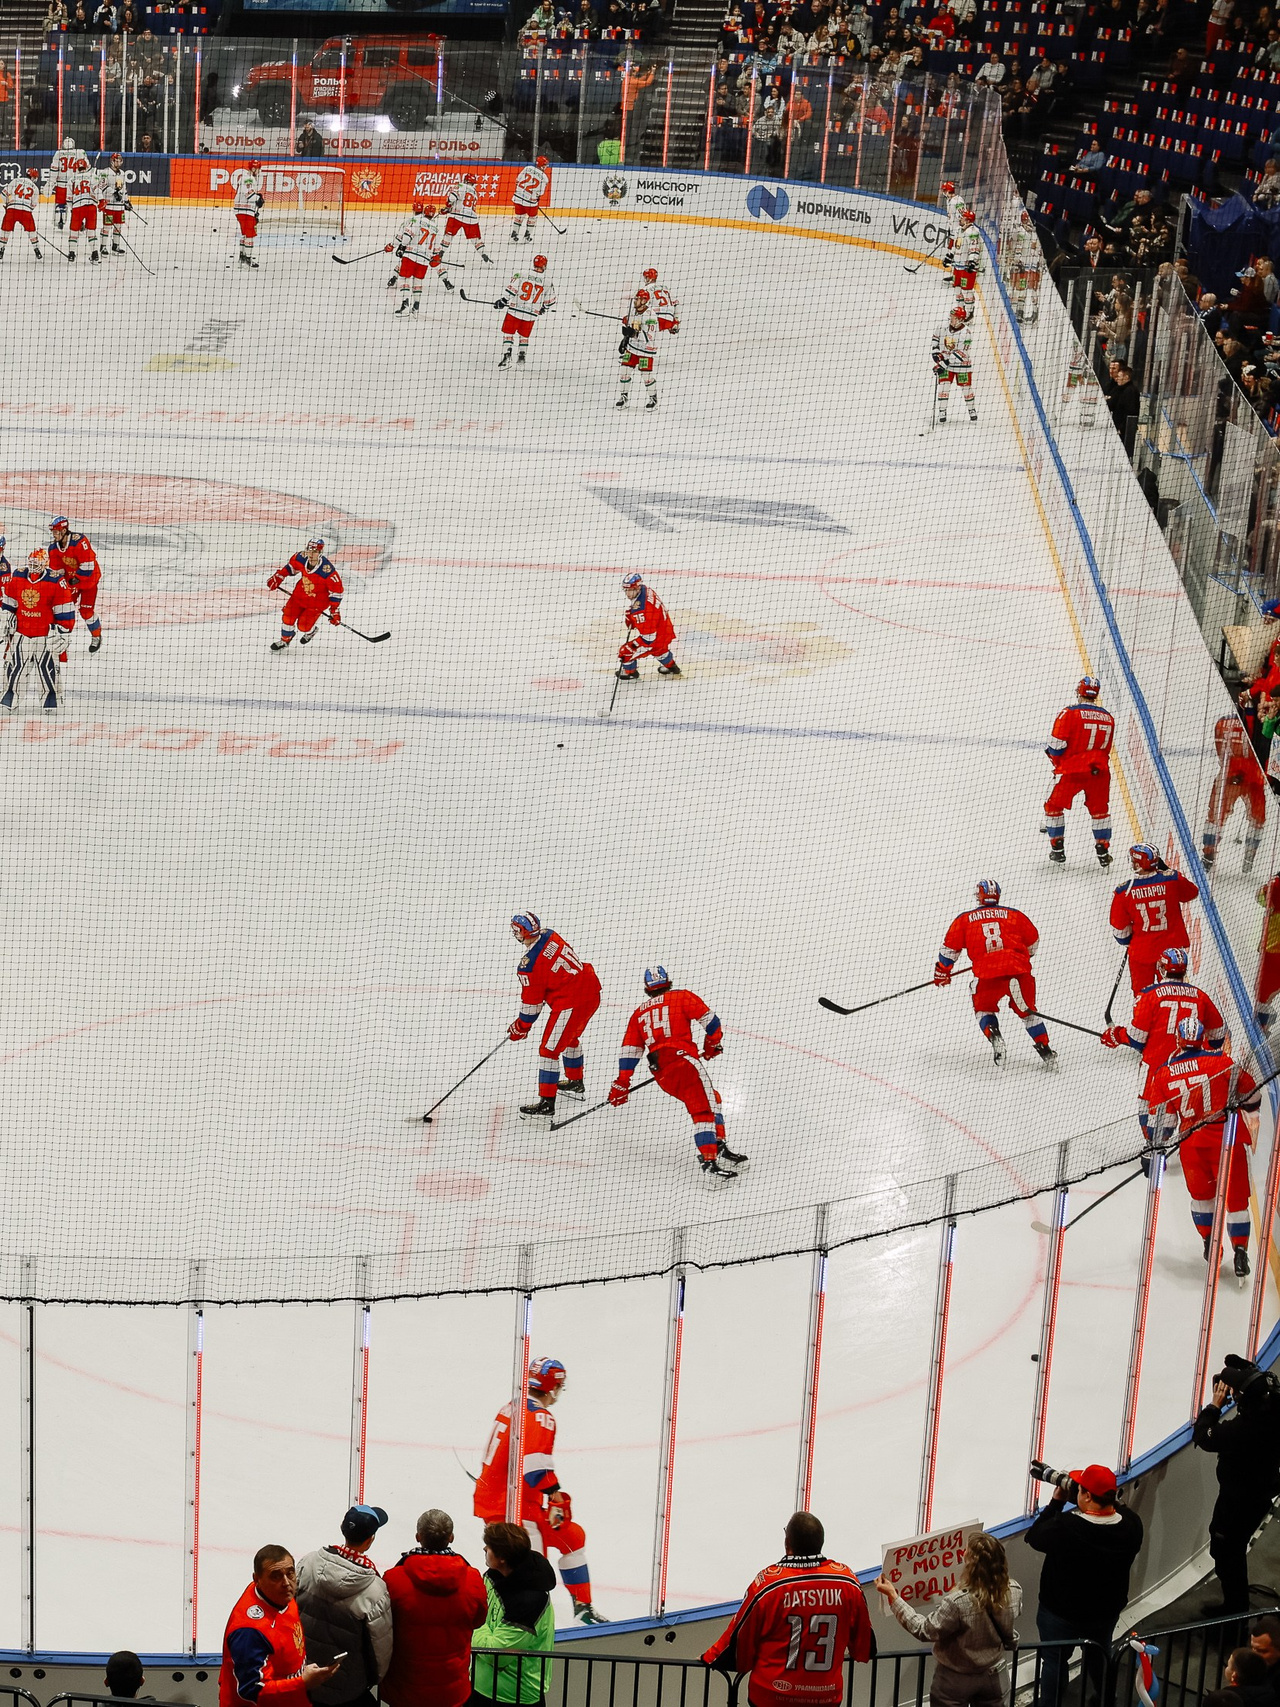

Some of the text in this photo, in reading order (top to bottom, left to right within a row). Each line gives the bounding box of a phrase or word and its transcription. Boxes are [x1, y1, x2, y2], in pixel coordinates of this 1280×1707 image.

[216, 135, 266, 147] РОЛЬФ
[428, 139, 481, 152] РОЛЬФ
[13, 183, 34, 200] 42
[72, 180, 91, 196] 46
[518, 173, 540, 195] 22
[636, 179, 700, 194] МИНСПОРТ
[636, 194, 684, 207] РОССИИ
[796, 200, 872, 225] НОРНИКЕЛЬ
[892, 214, 918, 239] VK
[417, 227, 436, 250] 71
[519, 281, 544, 304] 97
[1083, 723, 1112, 751] 77
[968, 909, 1009, 923] KANTSEROV
[1135, 899, 1169, 932] 13
[981, 921, 1004, 954] 8
[550, 943, 584, 976] 70
[637, 1005, 672, 1047] 34
[534, 1411, 556, 1432] 96
[893, 1529, 963, 1566] РОССИЯ
[783, 1588, 843, 1609] DATSYUK
[785, 1613, 839, 1672] 13
